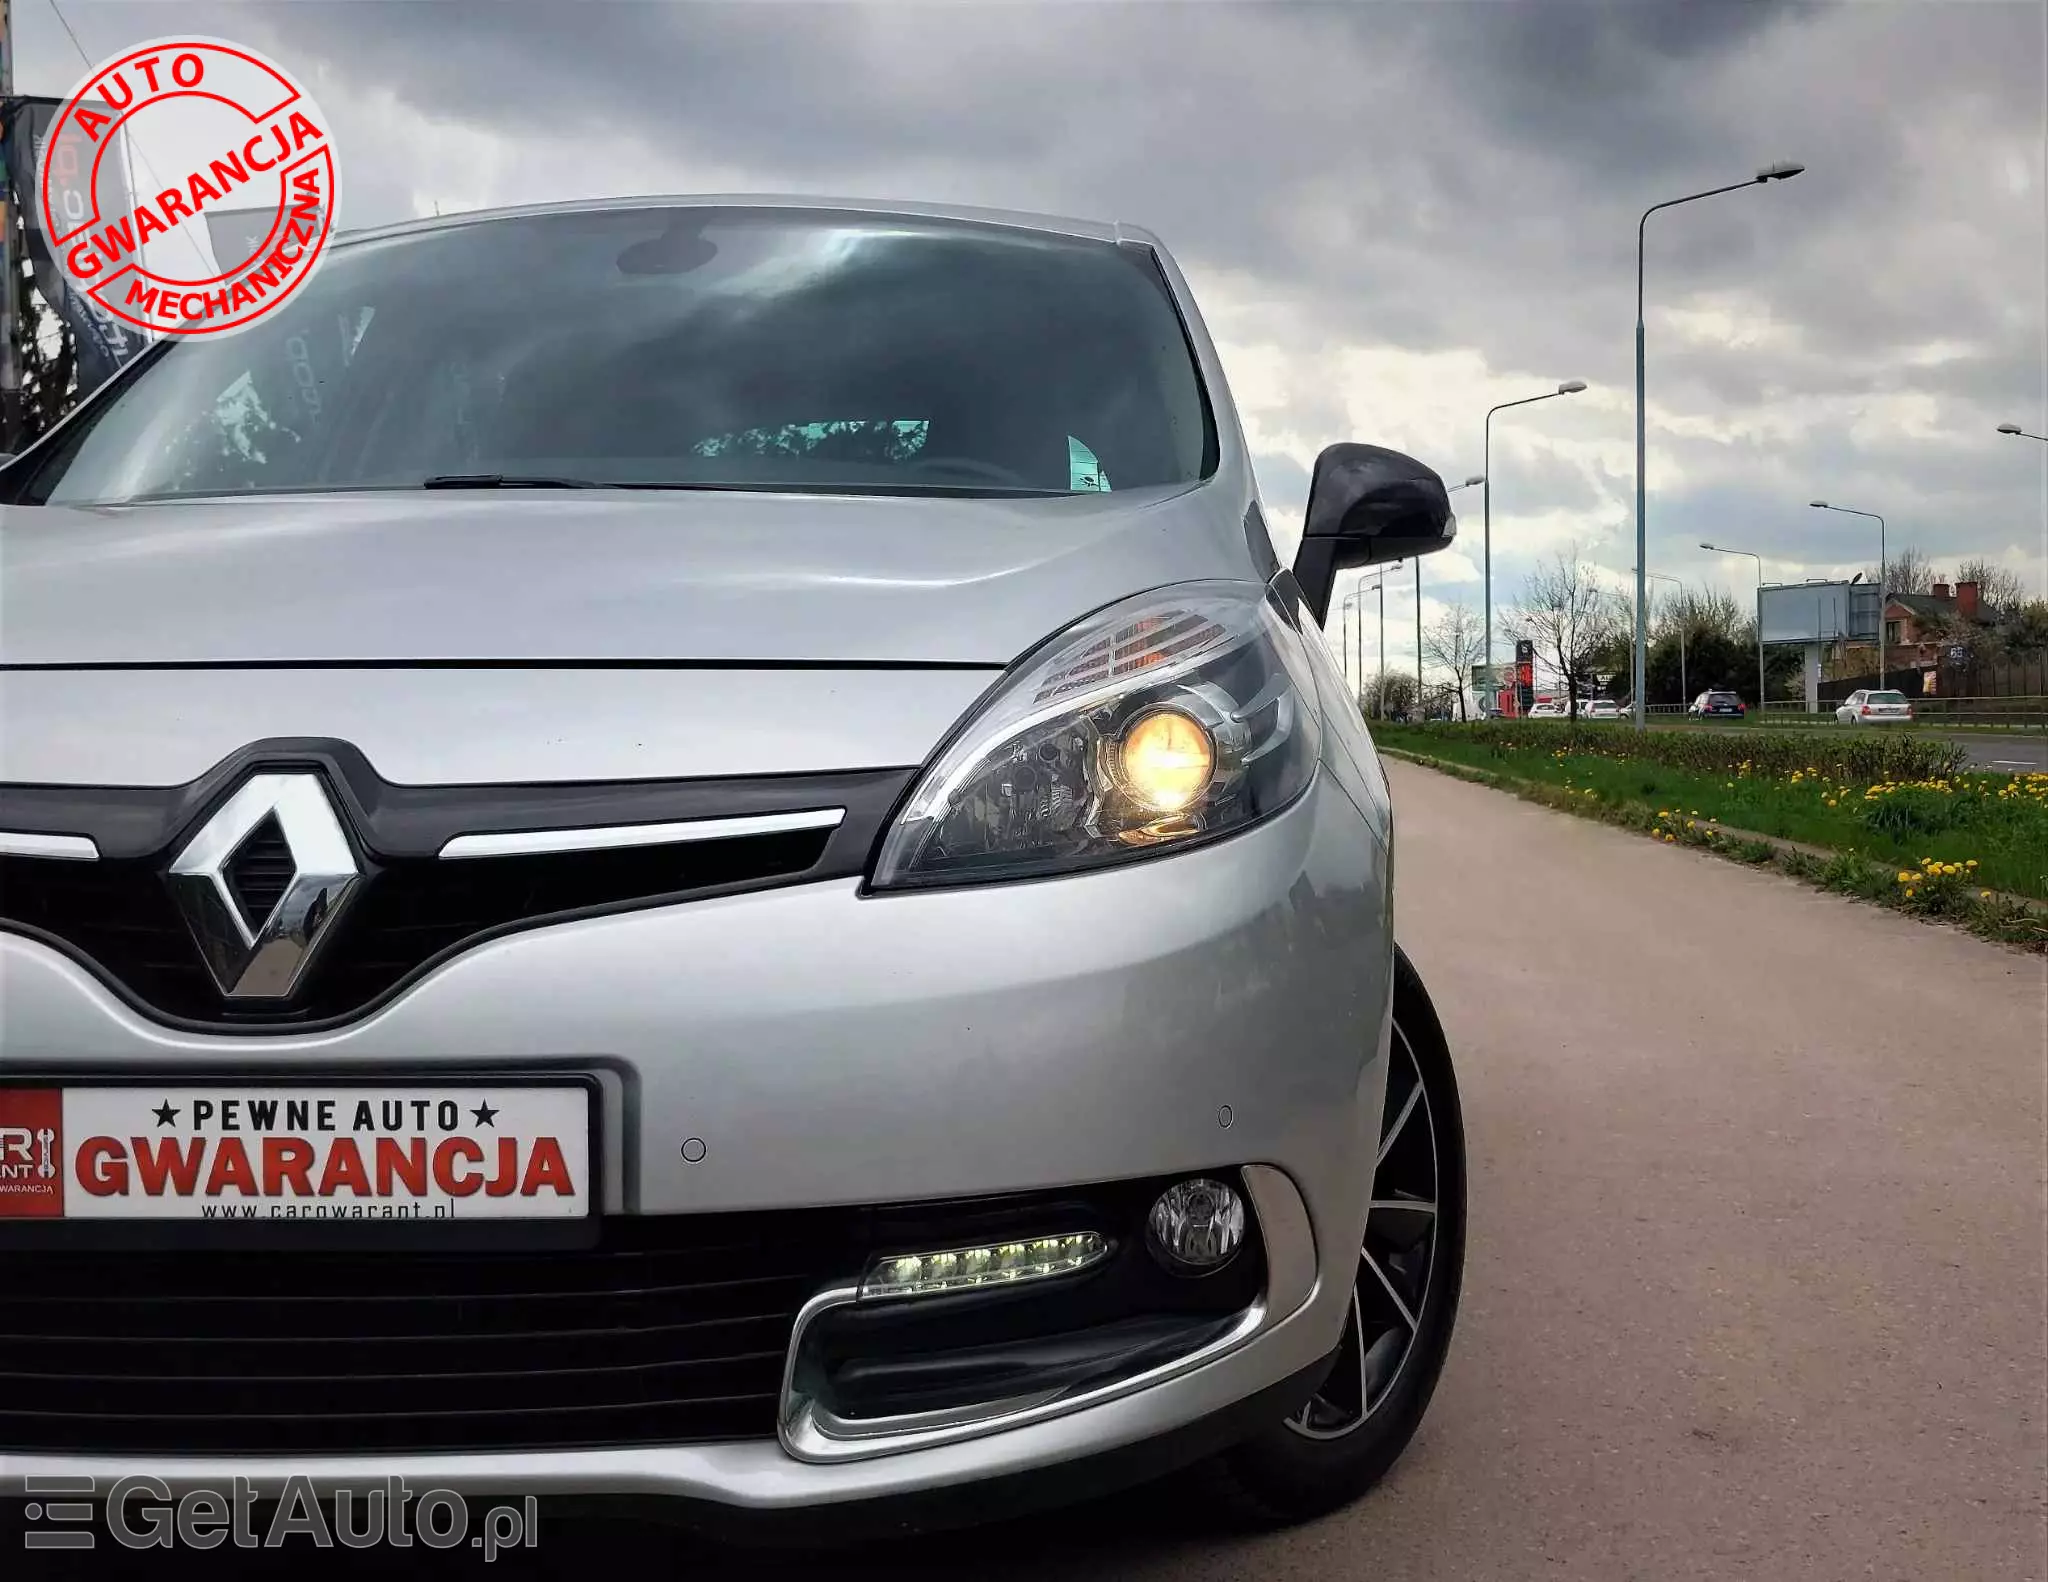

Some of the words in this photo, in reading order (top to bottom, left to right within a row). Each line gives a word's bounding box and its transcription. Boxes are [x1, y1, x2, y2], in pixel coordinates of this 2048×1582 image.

[193, 1100, 336, 1131] PEWNE
[352, 1100, 459, 1132] AUTO
[0, 1164, 33, 1179] NT
[74, 1136, 575, 1196] GWARANCJA
